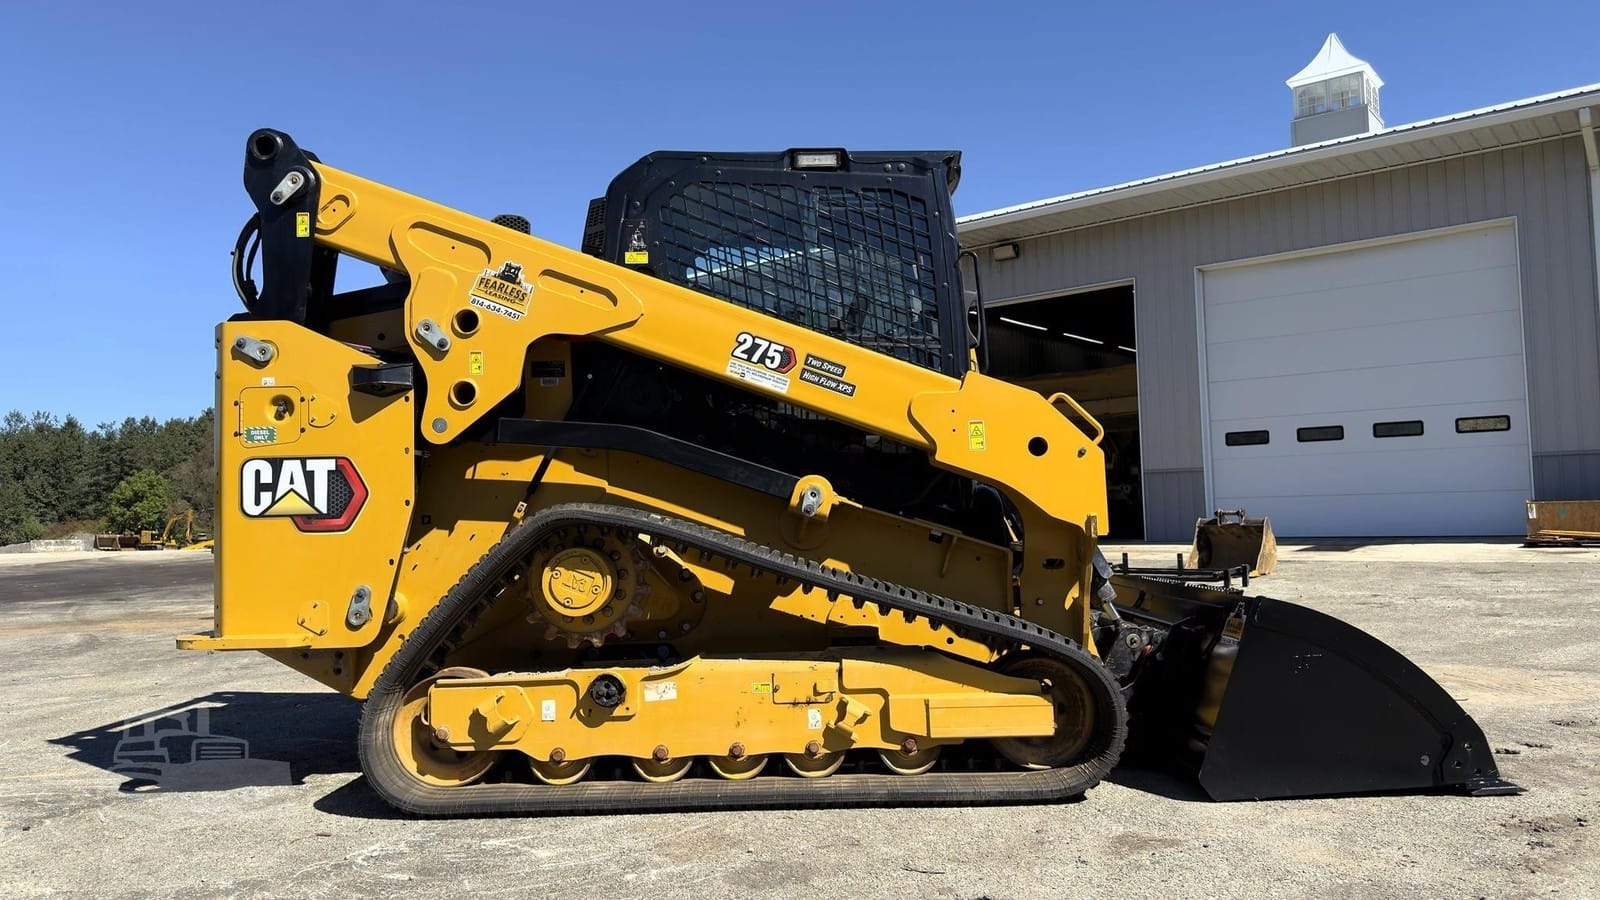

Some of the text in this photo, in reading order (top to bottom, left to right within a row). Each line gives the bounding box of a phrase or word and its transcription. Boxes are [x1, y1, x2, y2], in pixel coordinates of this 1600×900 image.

[478, 277, 527, 302] FEARLESS
[484, 290, 516, 304] LEASING
[470, 298, 521, 320] 814-634-7451
[732, 333, 785, 369] 275
[838, 383, 853, 393] XPS
[242, 459, 336, 516] CAT
